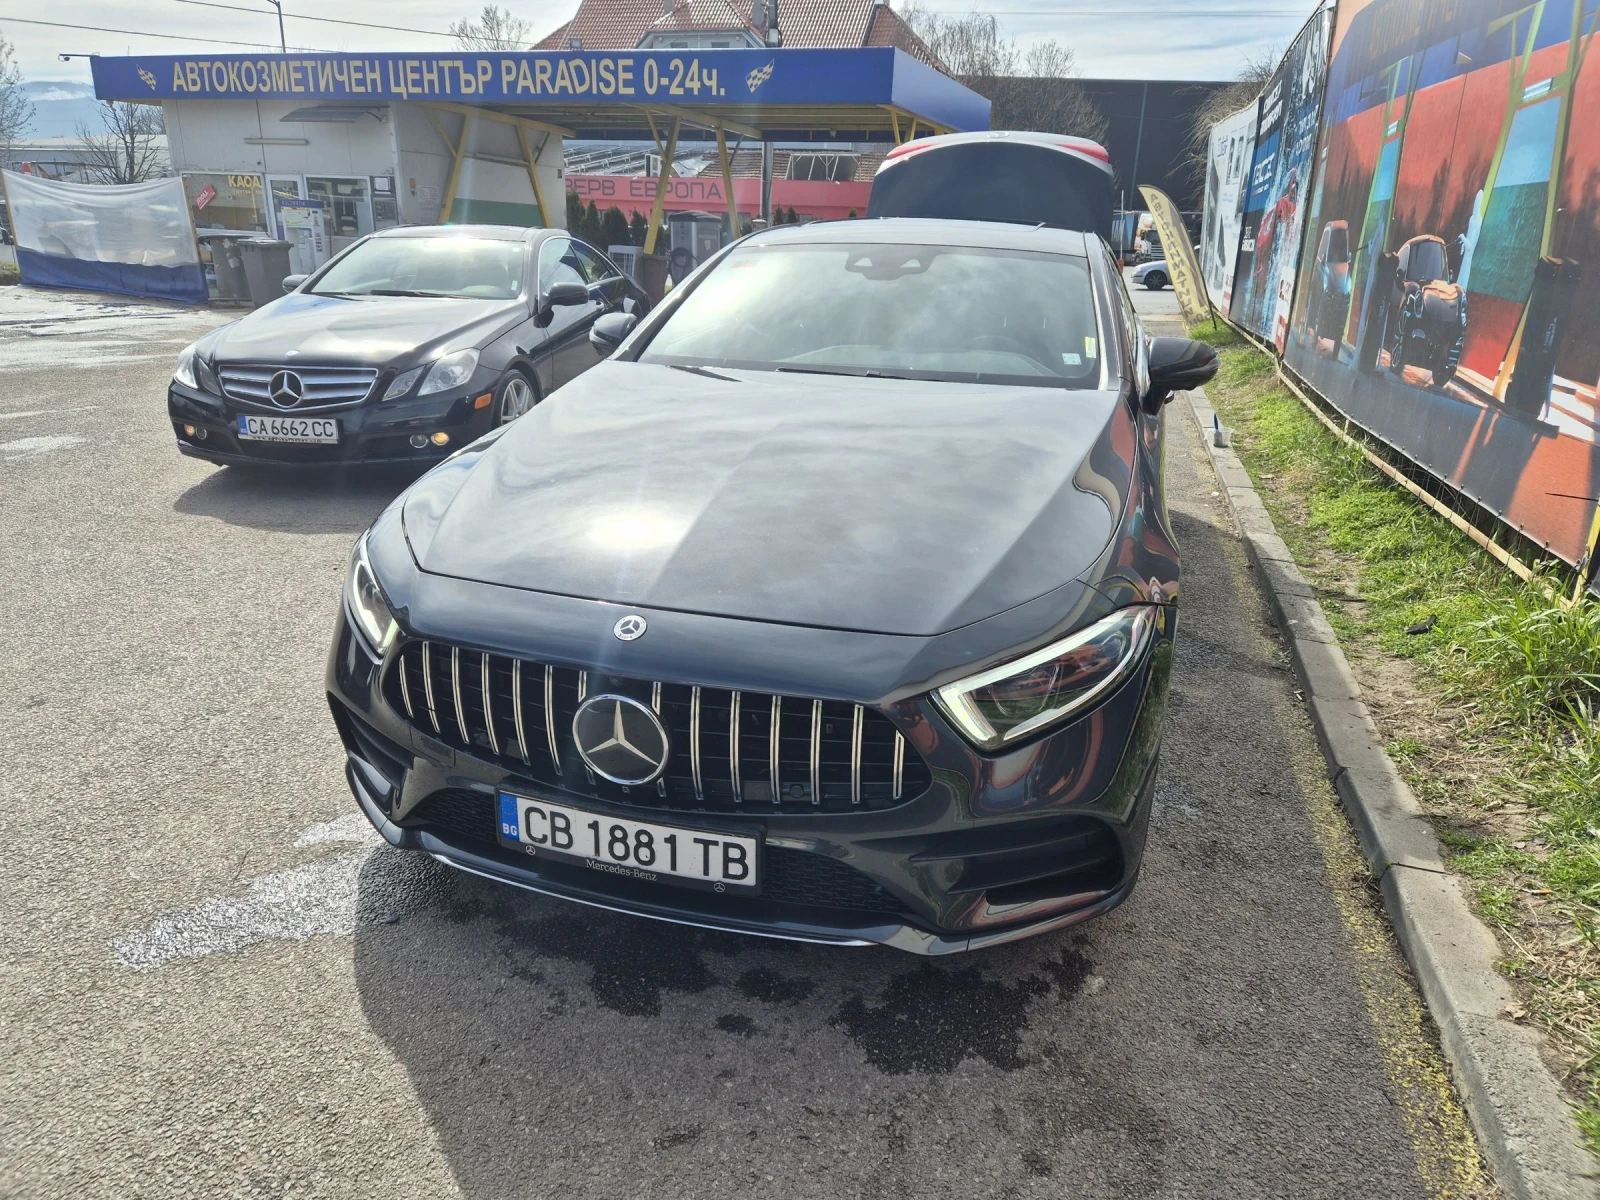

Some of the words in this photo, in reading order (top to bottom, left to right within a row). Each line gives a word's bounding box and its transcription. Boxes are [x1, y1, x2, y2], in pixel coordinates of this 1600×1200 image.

[172, 59, 382, 94] АВТОКОЗМЕТИЧЕН
[388, 59, 493, 99] ЦЕНТЪР
[501, 58, 635, 95] PARADISE
[271, 419, 309, 437] 6662
[502, 822, 518, 837] BG
[524, 806, 574, 850] CB
[587, 819, 677, 872] 1881
[693, 837, 749, 881] TB
[586, 858, 658, 882] Mercedes-Benz
